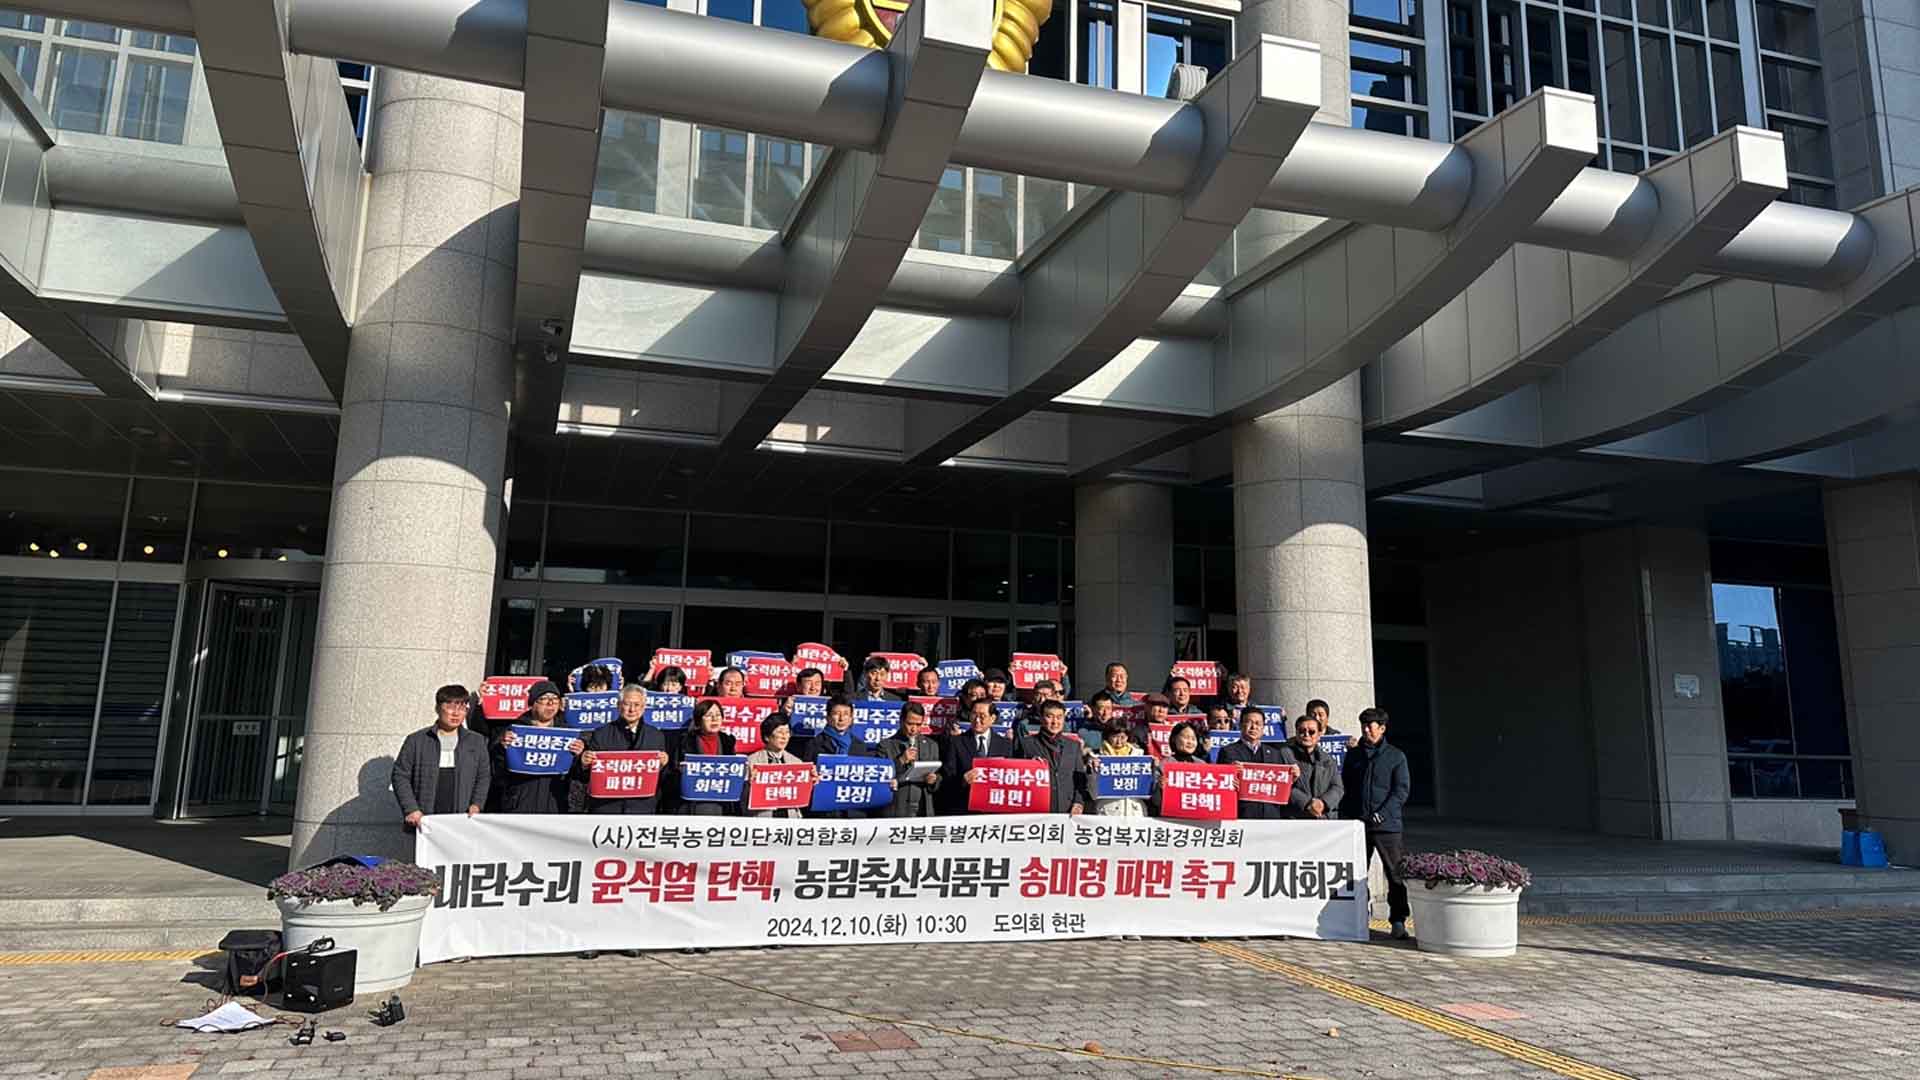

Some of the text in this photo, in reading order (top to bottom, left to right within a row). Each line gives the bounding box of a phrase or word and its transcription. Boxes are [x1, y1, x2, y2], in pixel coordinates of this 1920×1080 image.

[651, 709, 683, 723] 회복!
[723, 705, 772, 723] 란수괴
[853, 708, 900, 725] 민주주
[524, 751, 557, 767] 보장!
[592, 759, 660, 774] 조력하수인
[687, 761, 744, 778] 민주주의
[756, 770, 811, 784] 내란수괴
[818, 764, 893, 783] 농민생존권
[976, 766, 1049, 786] 조력하수인
[1242, 769, 1290, 784] 내란수괴
[605, 776, 642, 790] 파면!
[695, 779, 730, 793] 회복!
[1113, 777, 1138, 790] 보장!
[1168, 770, 1238, 791] 내란수괴
[765, 785, 798, 801] 탄핵!
[835, 785, 873, 803] 보장!
[988, 788, 1032, 808] 파면!
[1248, 784, 1277, 796] 탄핵!
[1181, 792, 1222, 812] 탄핵!
[592, 824, 858, 849] (사)전북농업인단체연합회
[888, 822, 1065, 845] 전북특별자치도의회
[1074, 823, 1244, 849] 농업복지환경위원회
[434, 856, 1357, 910] 내란수괴 윤석열 탄핵, 농림축산식품부 송미령 파면 촉구 기자회견
[767, 912, 1087, 938] 2024.12.10.(화) 10:30 도의회 현관
